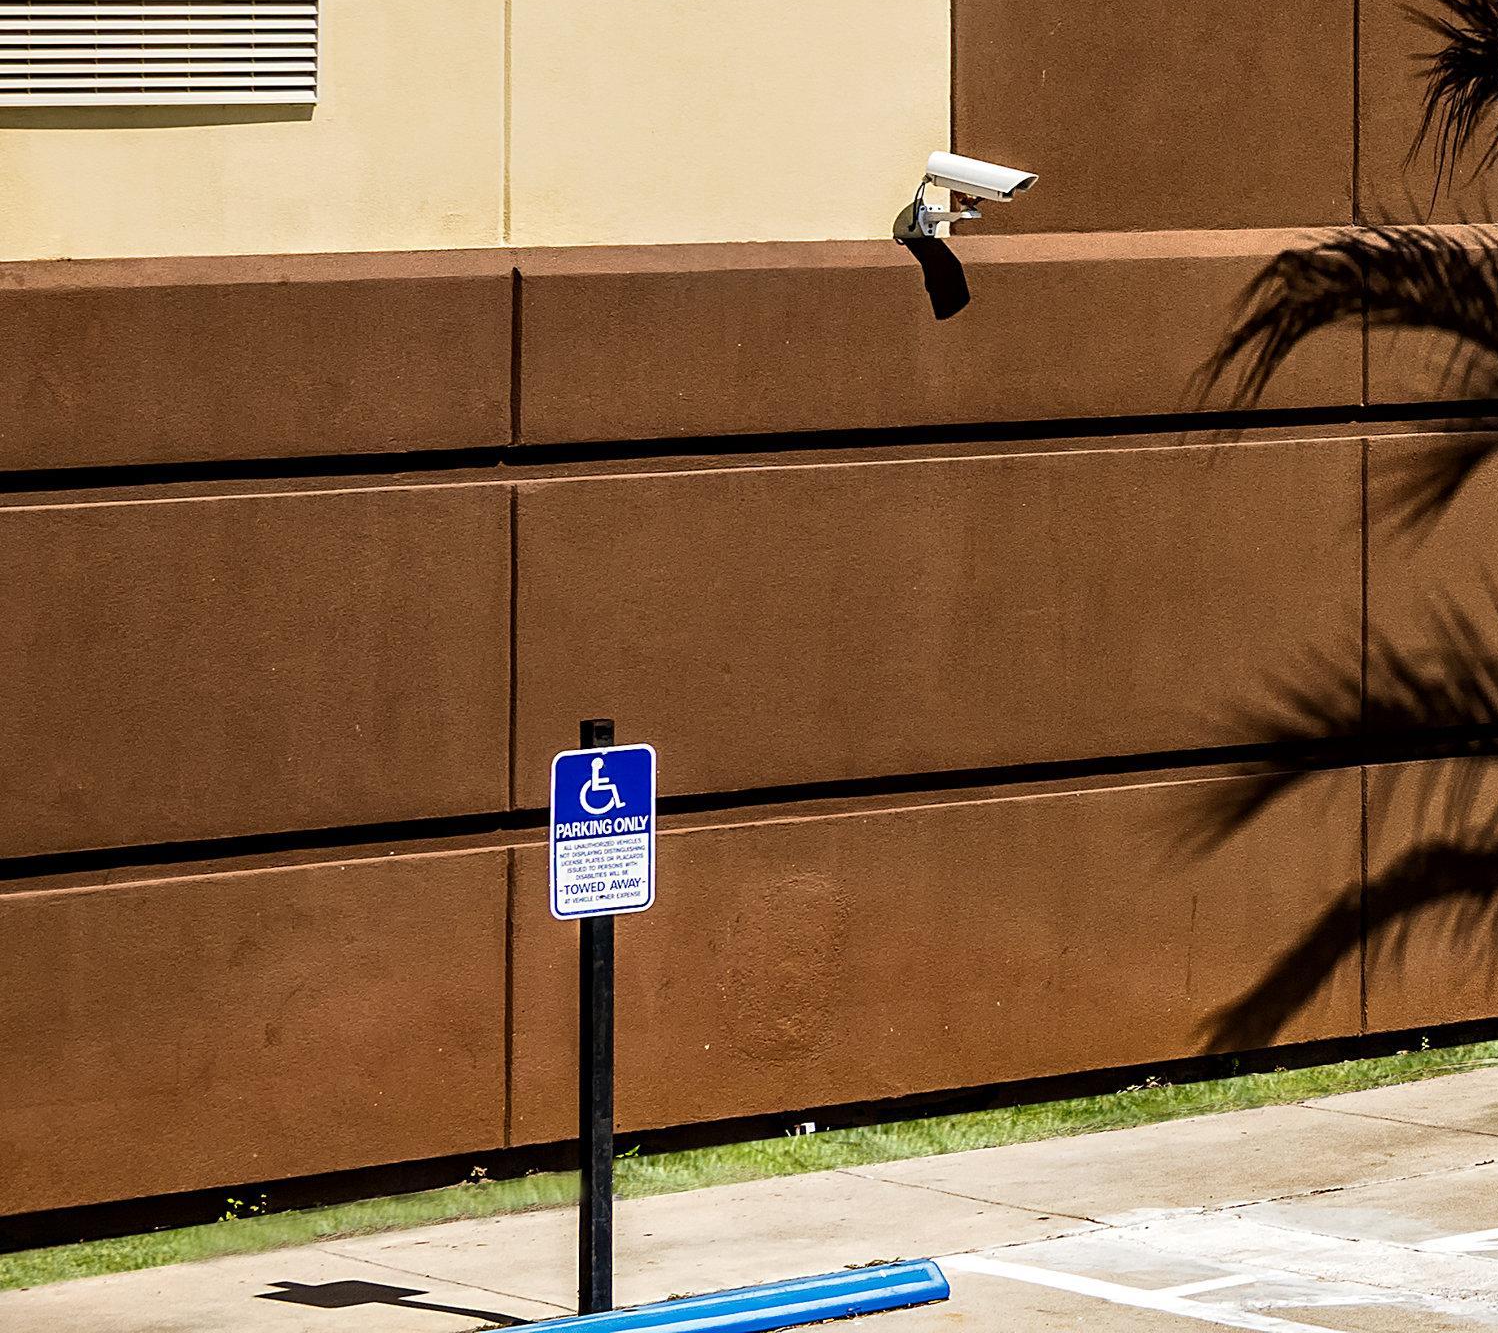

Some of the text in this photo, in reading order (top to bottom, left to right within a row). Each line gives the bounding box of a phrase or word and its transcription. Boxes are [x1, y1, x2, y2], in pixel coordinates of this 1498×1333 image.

[556, 815, 649, 839] PARKING ONLY
[575, 841, 615, 850] UNAUTHORIZED
[572, 849, 602, 857] DISPLAYING
[604, 845, 645, 854] DISTINGUISHING
[576, 872, 607, 880] DISABILITIES
[617, 891, 641, 899] EXPENSE
